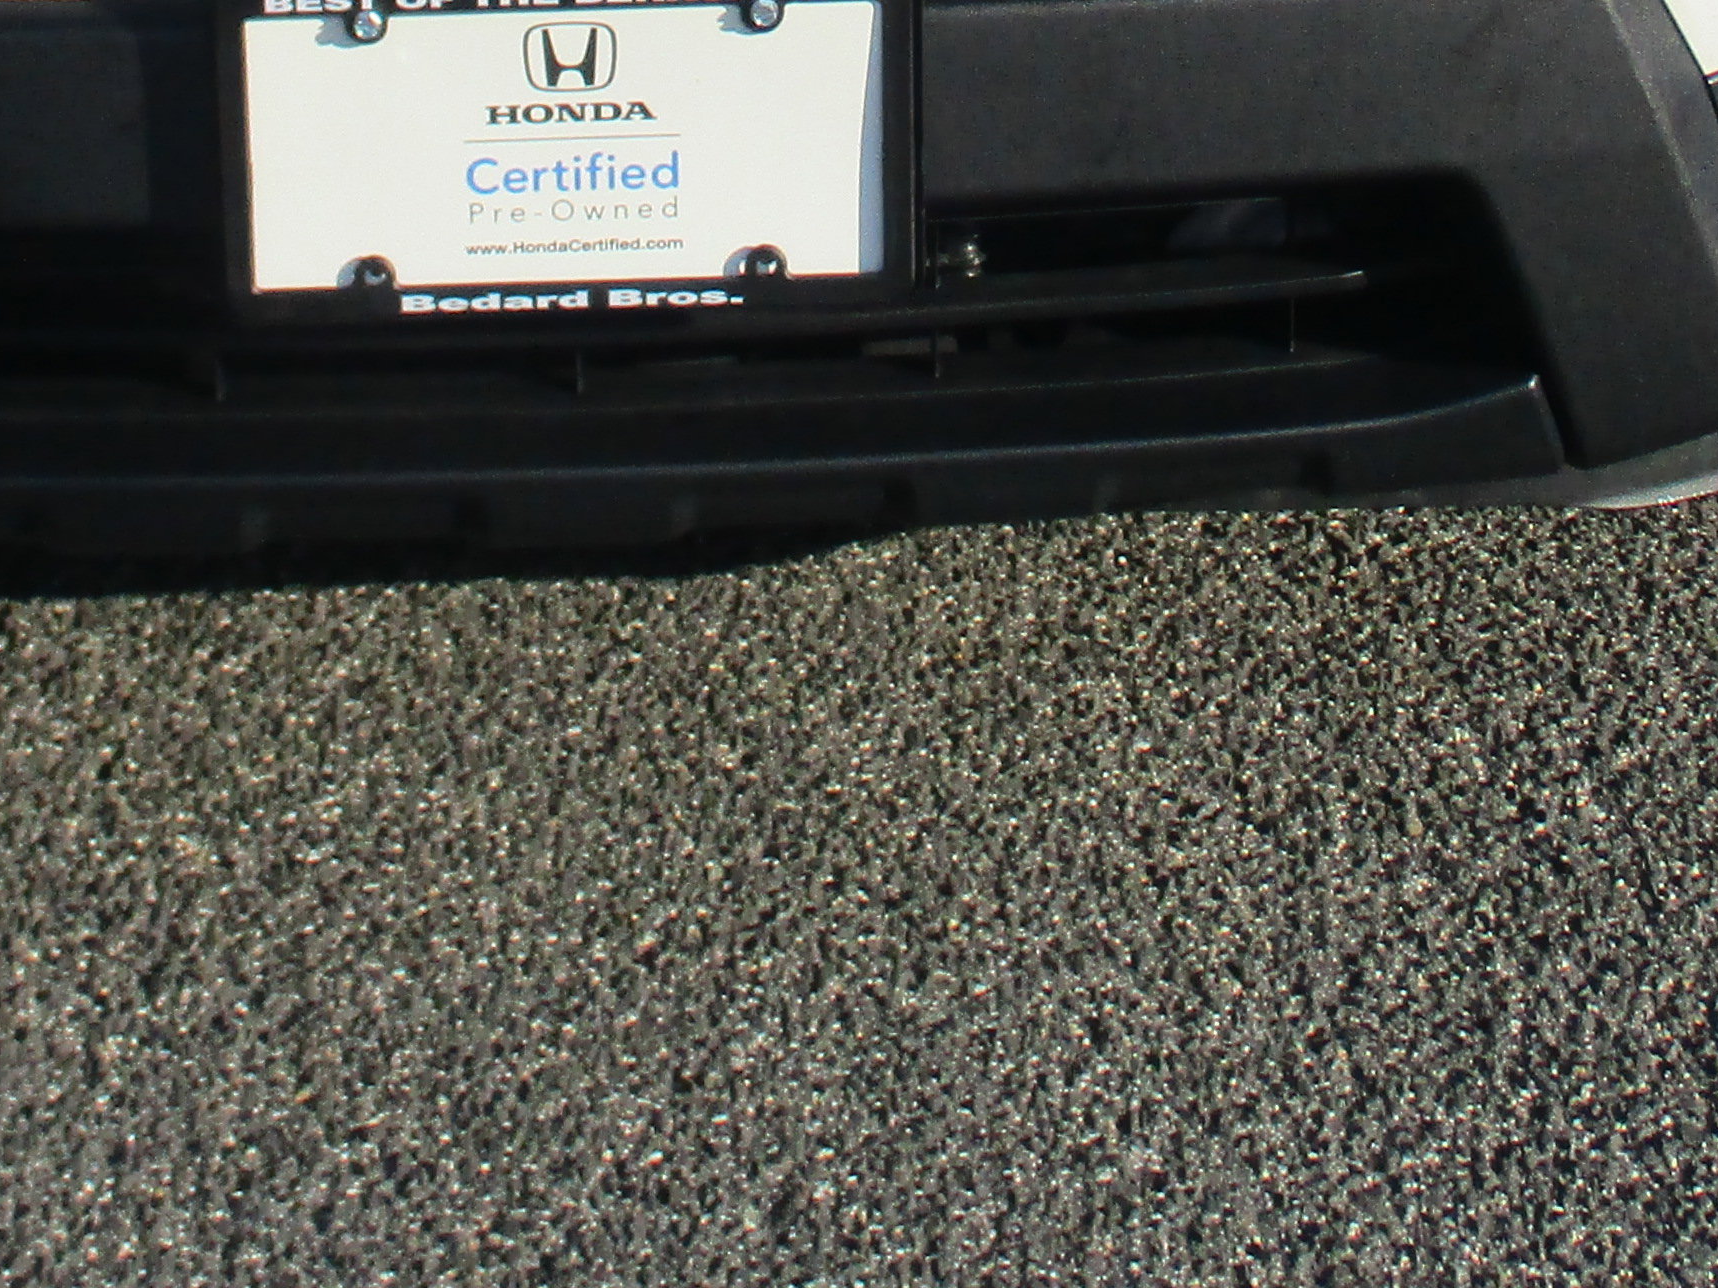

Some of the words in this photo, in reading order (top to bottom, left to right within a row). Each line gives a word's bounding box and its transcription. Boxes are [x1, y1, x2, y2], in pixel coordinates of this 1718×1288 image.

[485, 101, 657, 125] HONDA
[466, 150, 679, 194] Certified
[469, 196, 678, 224] Pre-Owned
[466, 237, 684, 255] www.HondaCertified.com
[401, 291, 589, 314] Bedard
[608, 289, 744, 308] Bros.
